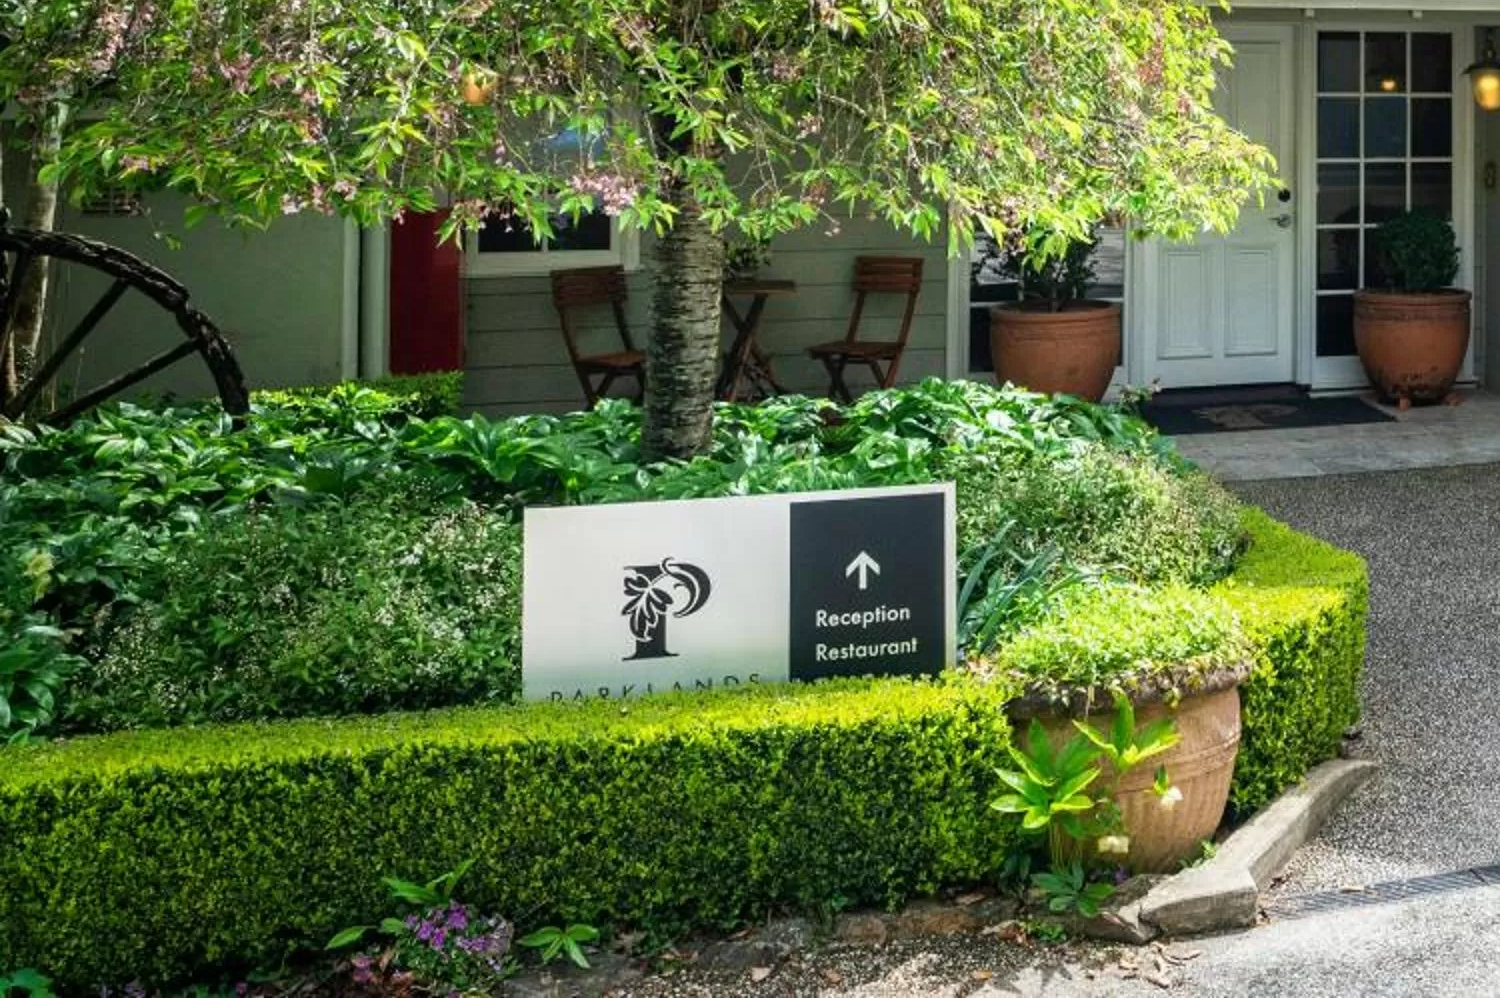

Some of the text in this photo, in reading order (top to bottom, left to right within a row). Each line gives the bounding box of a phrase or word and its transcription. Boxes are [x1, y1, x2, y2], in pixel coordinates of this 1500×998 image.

[621, 557, 711, 661] P
[815, 605, 911, 629] Reception
[815, 637, 918, 662] Restaurant
